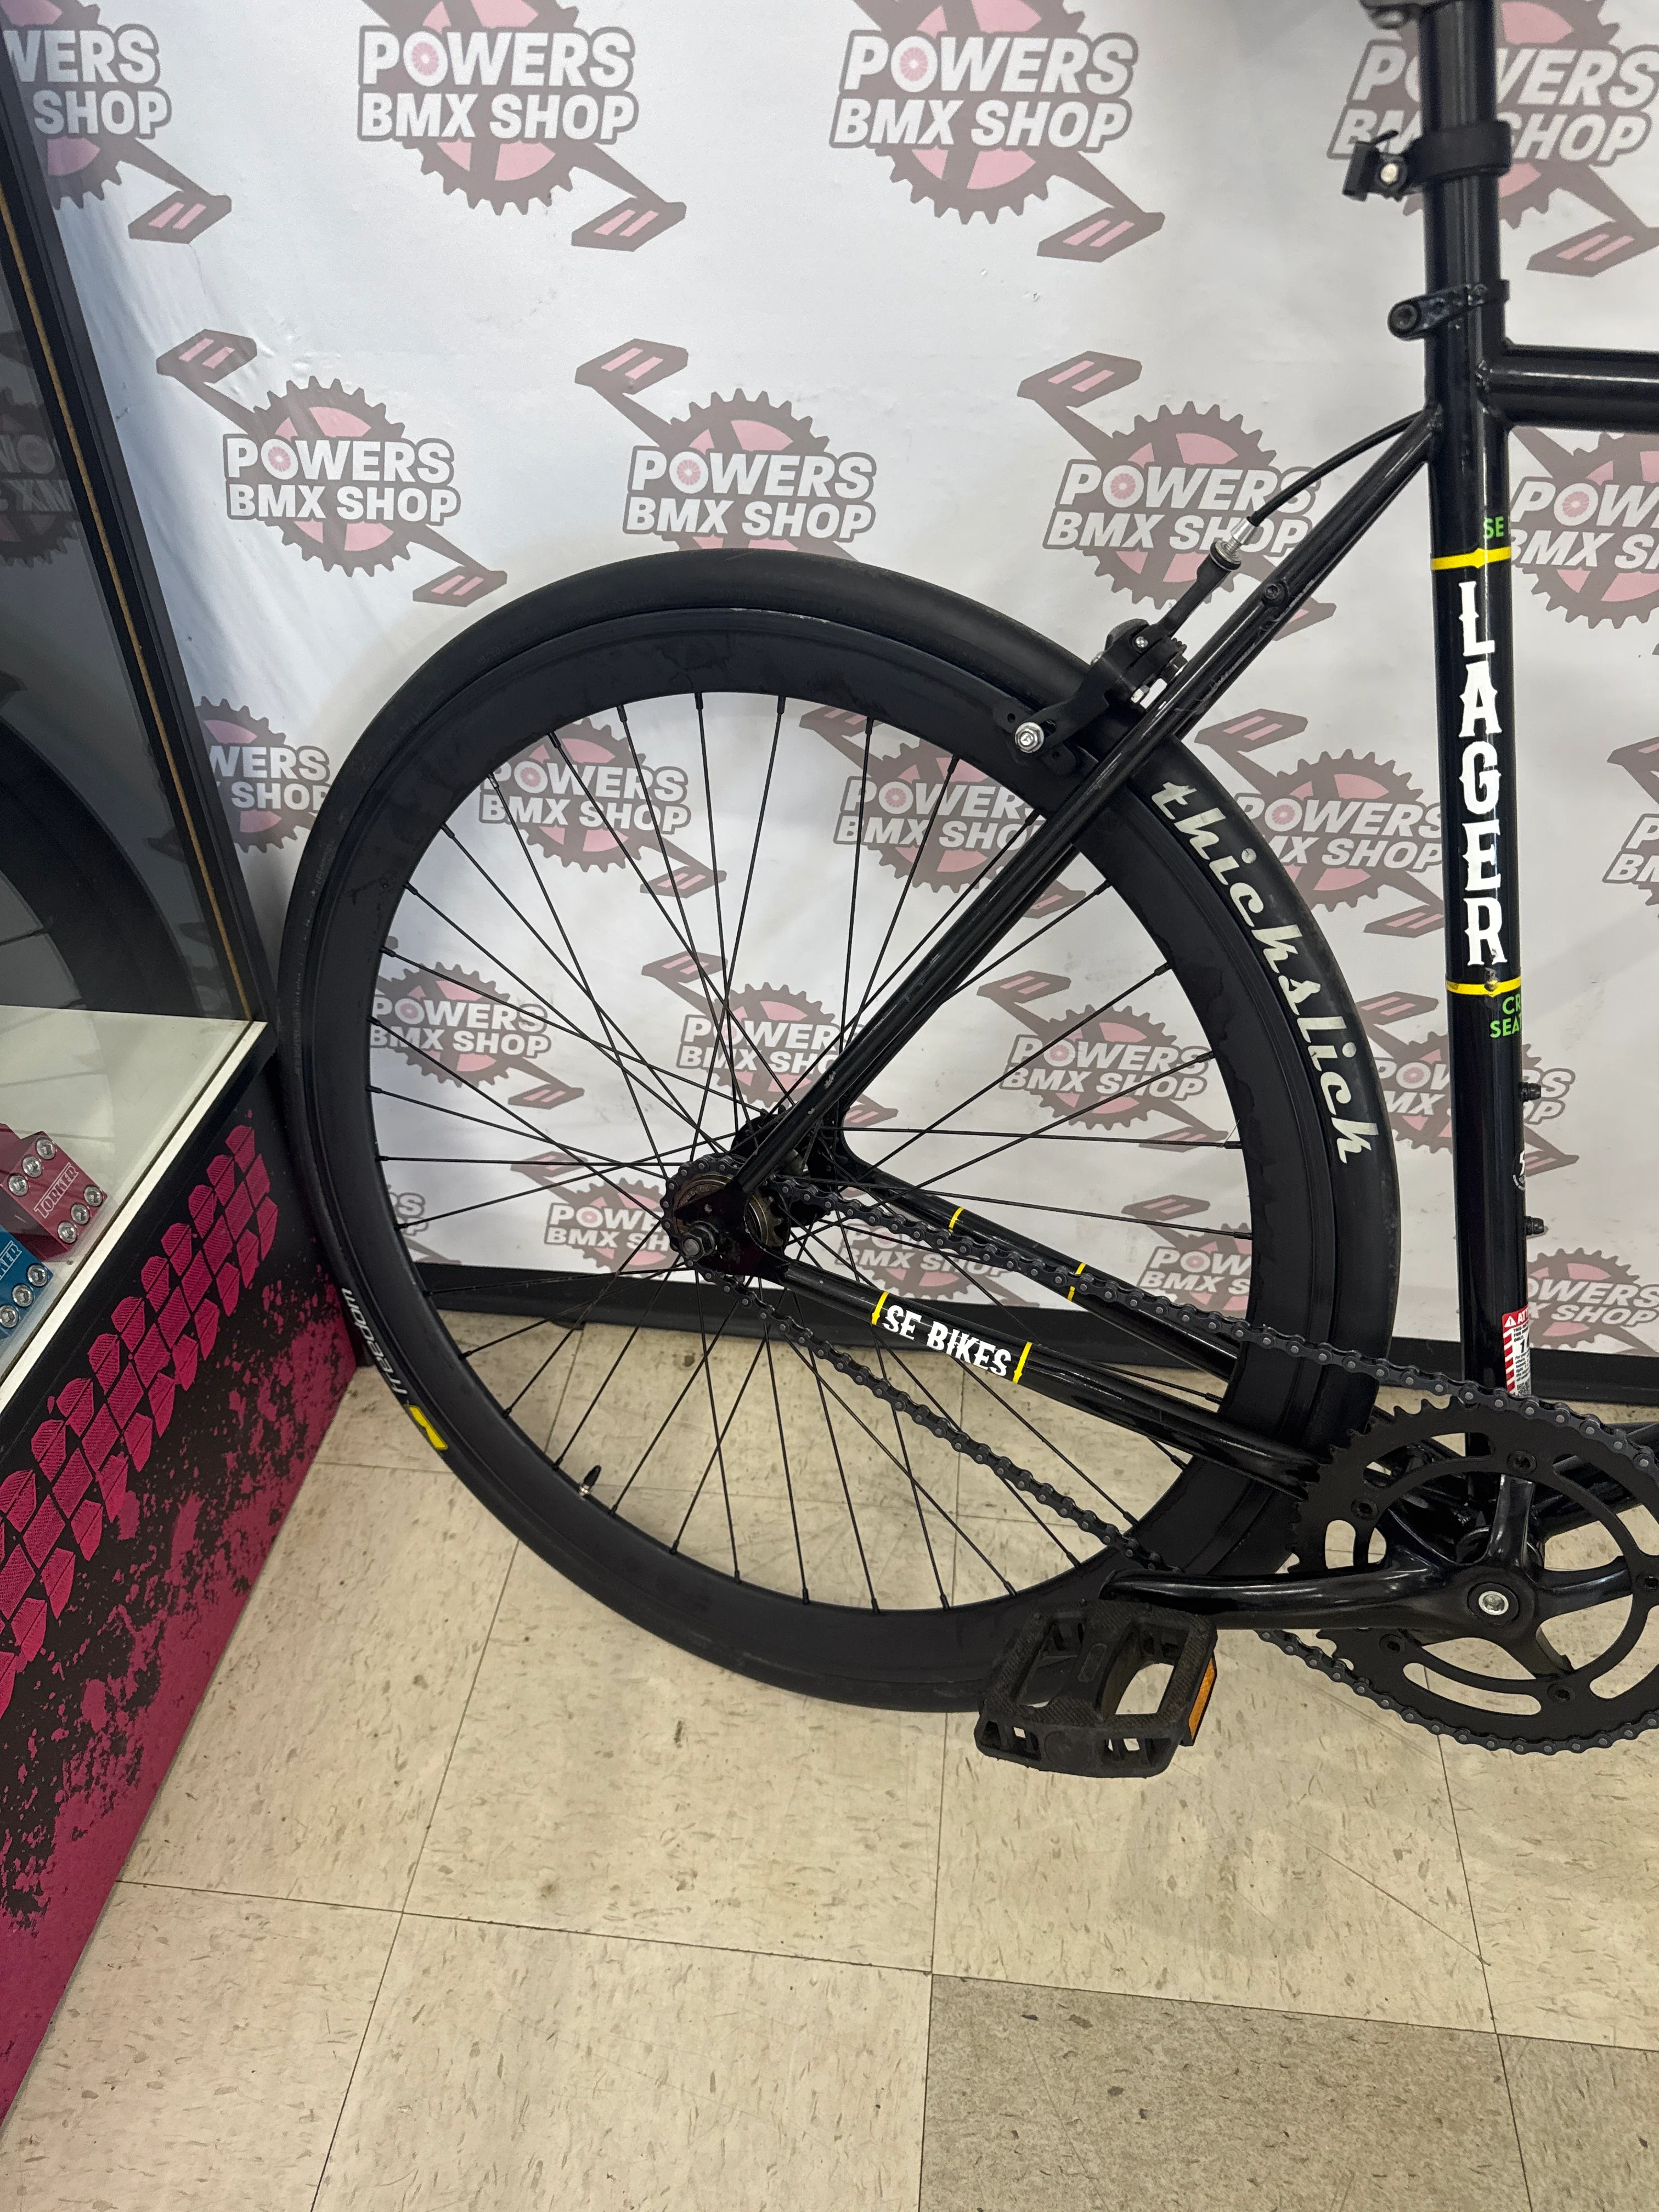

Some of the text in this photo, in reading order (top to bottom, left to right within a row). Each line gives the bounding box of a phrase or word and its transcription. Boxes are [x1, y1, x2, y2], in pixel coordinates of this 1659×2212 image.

[3, 30, 156, 83] WERS
[362, 31, 631, 87] POWERS
[844, 36, 1133, 95] POWERS
[1352, 45, 1659, 108] PERS
[32, 90, 167, 134] SHOP
[361, 92, 634, 140] BMX SHOP
[833, 98, 1127, 148] BMX SHOP
[1497, 112, 1646, 161] HOP
[227, 438, 450, 483] POWERS
[632, 450, 872, 499] POWERS
[229, 483, 458, 522] BMX SHOP
[1060, 464, 1317, 514] POWERS
[1510, 481, 1659, 528] POW
[627, 497, 871, 539] BMX SHOP
[1047, 511, 1165, 548] BMX
[208, 745, 326, 781] WERS
[1458, 581, 1508, 967] LAGER
[482, 794, 689, 832] BMX SHOP
[844, 779, 1042, 821] POWER
[837, 815, 1041, 850] BMX SHO
[1322, 837, 1442, 870] SHOP
[373, 997, 545, 1032] POWERS
[370, 1024, 550, 1056] BMX SHOP
[679, 1046, 762, 1071] BMX
[1011, 1036, 1210, 1075] POWERS
[1002, 1066, 1203, 1099] BMX SHOP
[1384, 1090, 1446, 1115] MX
[33, 1162, 79, 1218] TORKER
[550, 1204, 665, 1232] POWE
[546, 1227, 670, 1251] BMX SH
[838, 1247, 916, 1268] BMX
[1139, 1270, 1225, 1293] BMX
[1149, 1248, 1251, 1276] POW
[1528, 1277, 1659, 1308] WERS
[1551, 1304, 1656, 1326] SHOP
[341, 1288, 408, 1395] freedom
[882, 1305, 1012, 1376] SE BIKES
